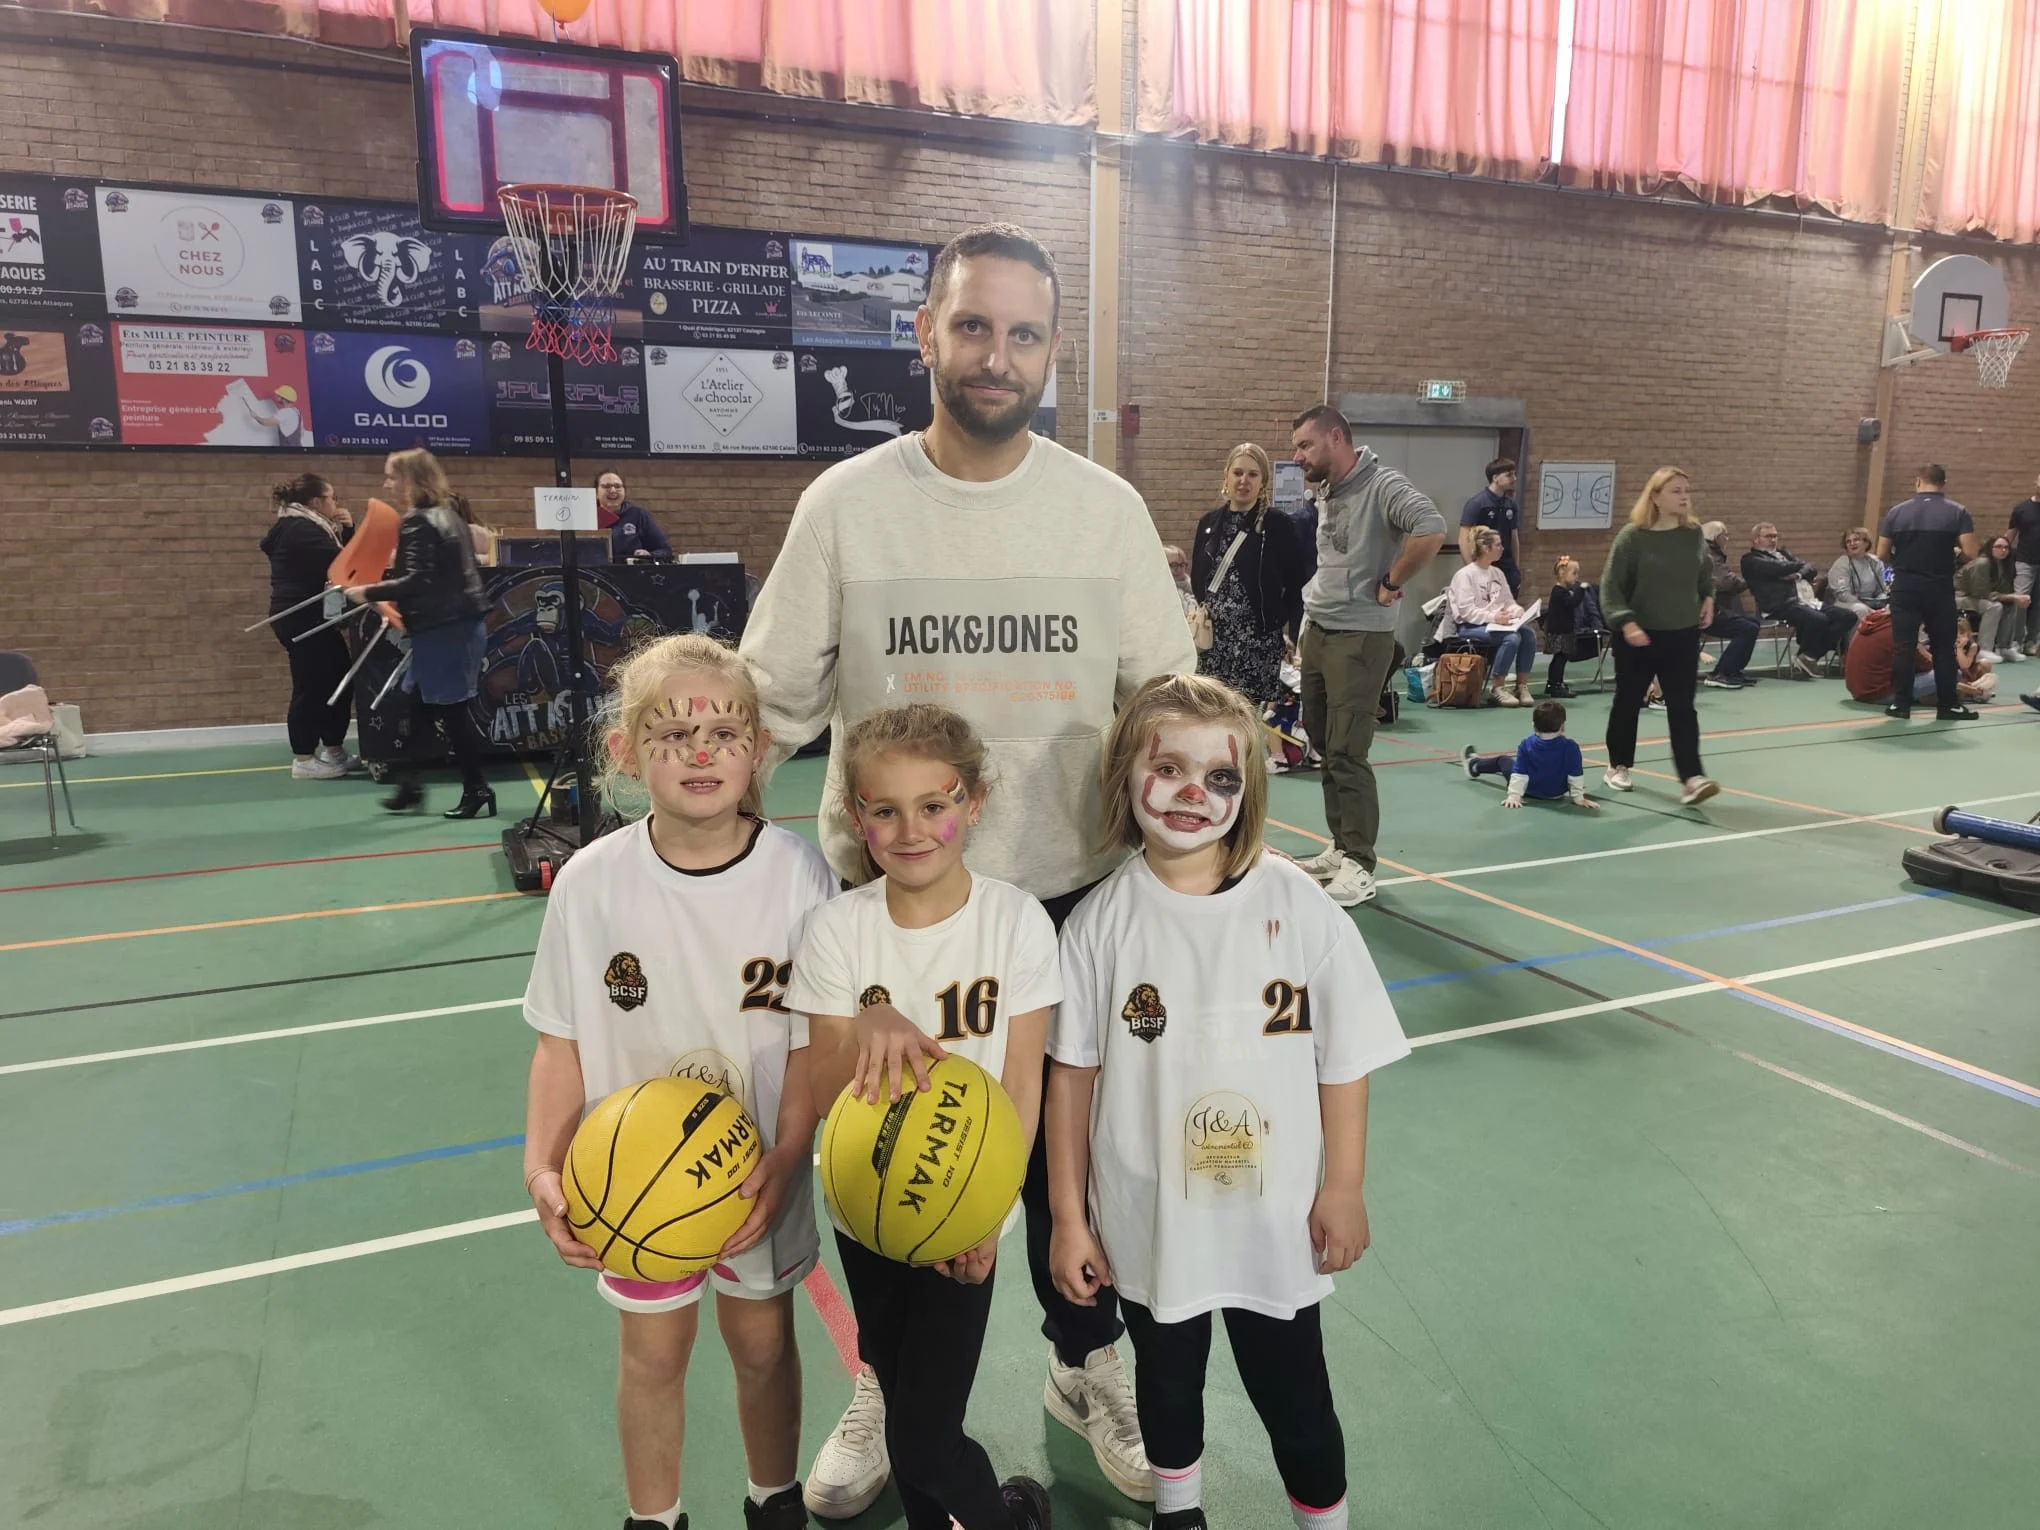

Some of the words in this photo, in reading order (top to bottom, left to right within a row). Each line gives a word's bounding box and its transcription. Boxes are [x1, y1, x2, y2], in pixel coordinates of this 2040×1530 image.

[179, 250, 222, 263] CHEZ
[179, 264, 224, 277] NOUS
[643, 257, 666, 271] AU
[671, 258, 721, 275] TRAIN
[726, 262, 790, 279] D'ENFER
[644, 277, 714, 293] BRASSERIE
[722, 281, 786, 297] GRILLADE
[692, 298, 742, 316] PIZZA
[122, 330, 140, 339] Ets
[143, 330, 184, 341] MILLE
[188, 331, 250, 343] PEINTURE
[149, 360, 162, 370] 03
[166, 361, 179, 371] 21
[183, 361, 196, 371] 83
[201, 362, 213, 372] 39
[218, 362, 230, 373] 22
[701, 379, 744, 391] L'Atelier
[705, 391, 752, 404] Chocolat
[121, 404, 167, 414] Entreprise
[122, 415, 160, 423] peinture
[885, 614, 1078, 656] JACK&JONES
[505, 692, 528, 705] LES
[611, 984, 646, 999] BCSF
[934, 975, 1000, 1042] 16
[1261, 978, 1312, 1037] 21
[1131, 1016, 1165, 1030] BCSF
[685, 1110, 754, 1189] ARMAK
[898, 1081, 968, 1215] TARMAK
